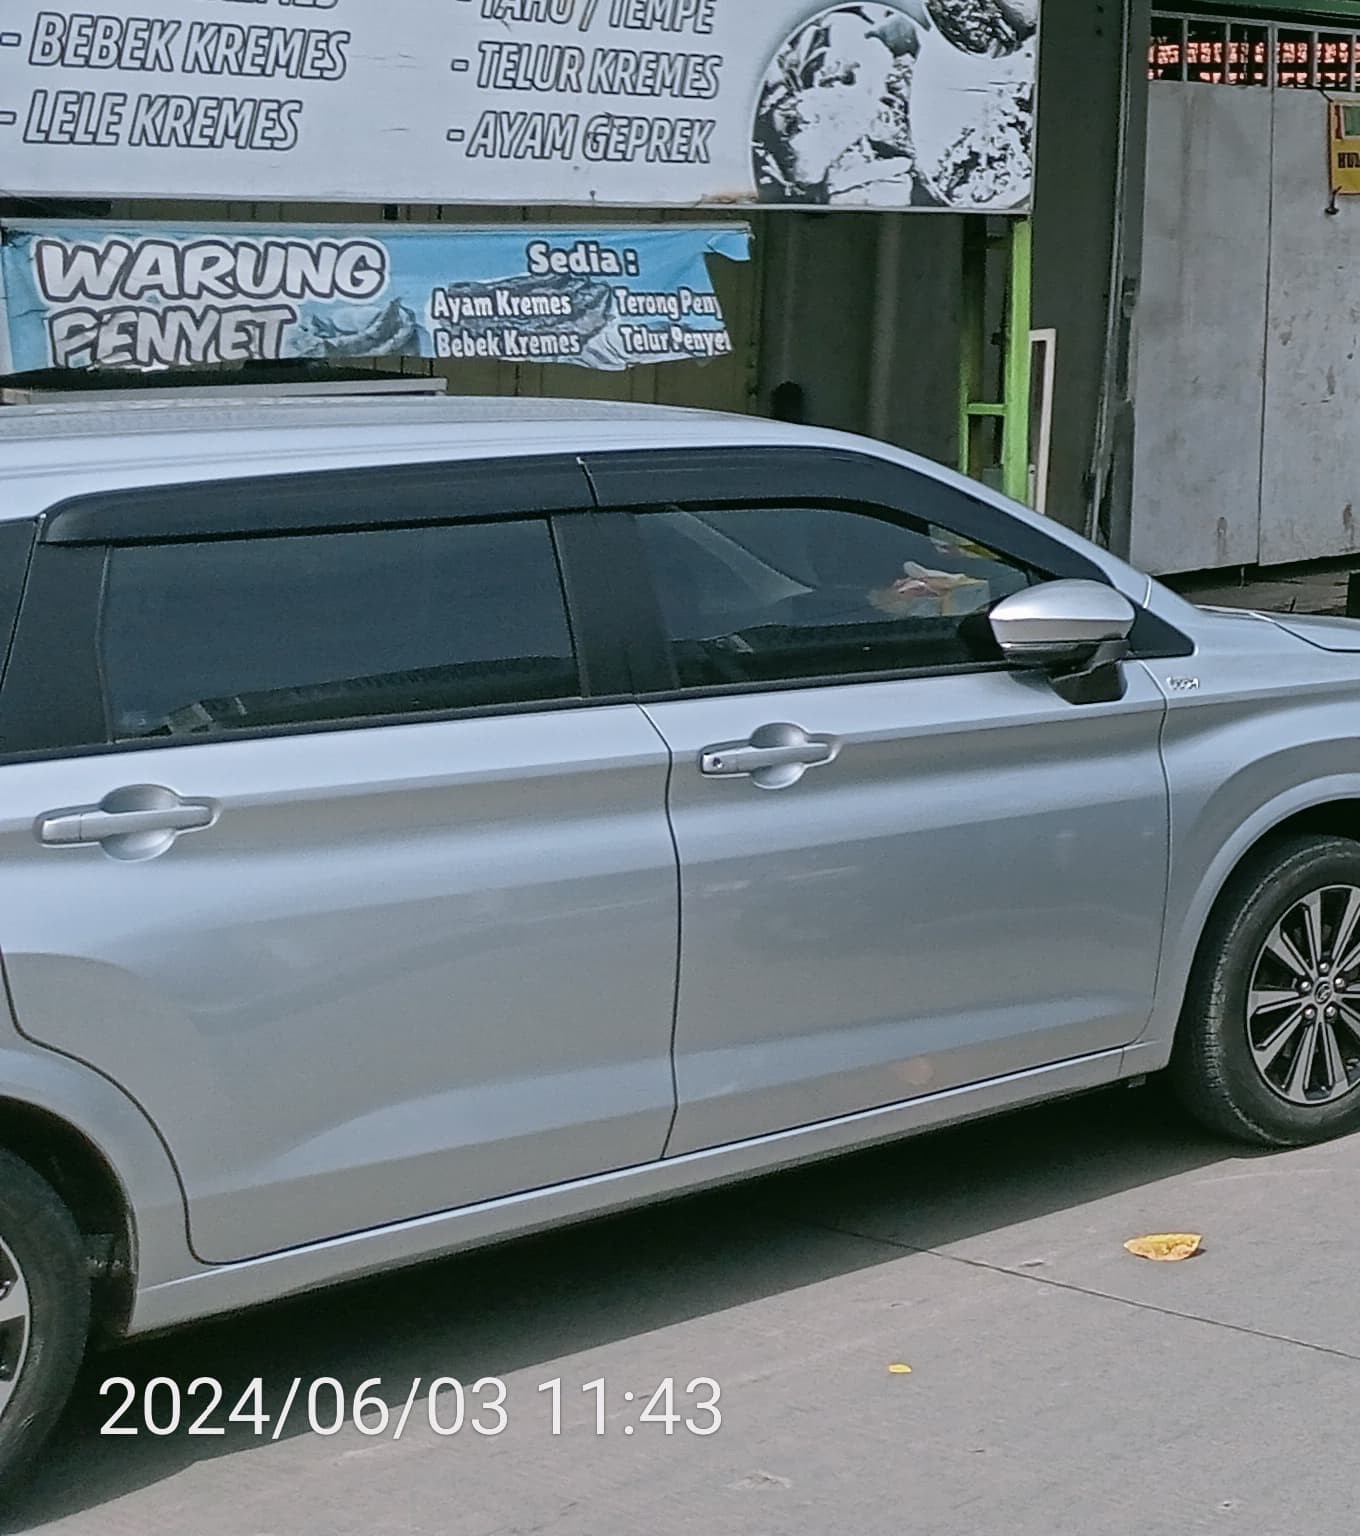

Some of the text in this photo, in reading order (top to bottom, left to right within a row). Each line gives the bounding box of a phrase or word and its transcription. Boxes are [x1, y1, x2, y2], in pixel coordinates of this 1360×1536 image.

[29, 12, 181, 72] BEBEK
[183, 21, 350, 80] KREMES
[477, 40, 584, 92] TELUR
[588, 48, 723, 99] KREMES
[23, 90, 127, 145] LELE
[129, 94, 302, 150] KREMES
[465, 110, 579, 160] AYAM
[582, 112, 716, 163] GEPREK
[36, 239, 386, 302] WARUNG
[527, 241, 622, 276] Sedia
[432, 288, 492, 323] Ayam
[495, 290, 573, 317] Kremes
[613, 288, 680, 319] Terong
[49, 305, 297, 368] PENYET
[434, 327, 501, 357] Bebek
[501, 330, 582, 356] Kremes
[619, 324, 669, 353] Telur
